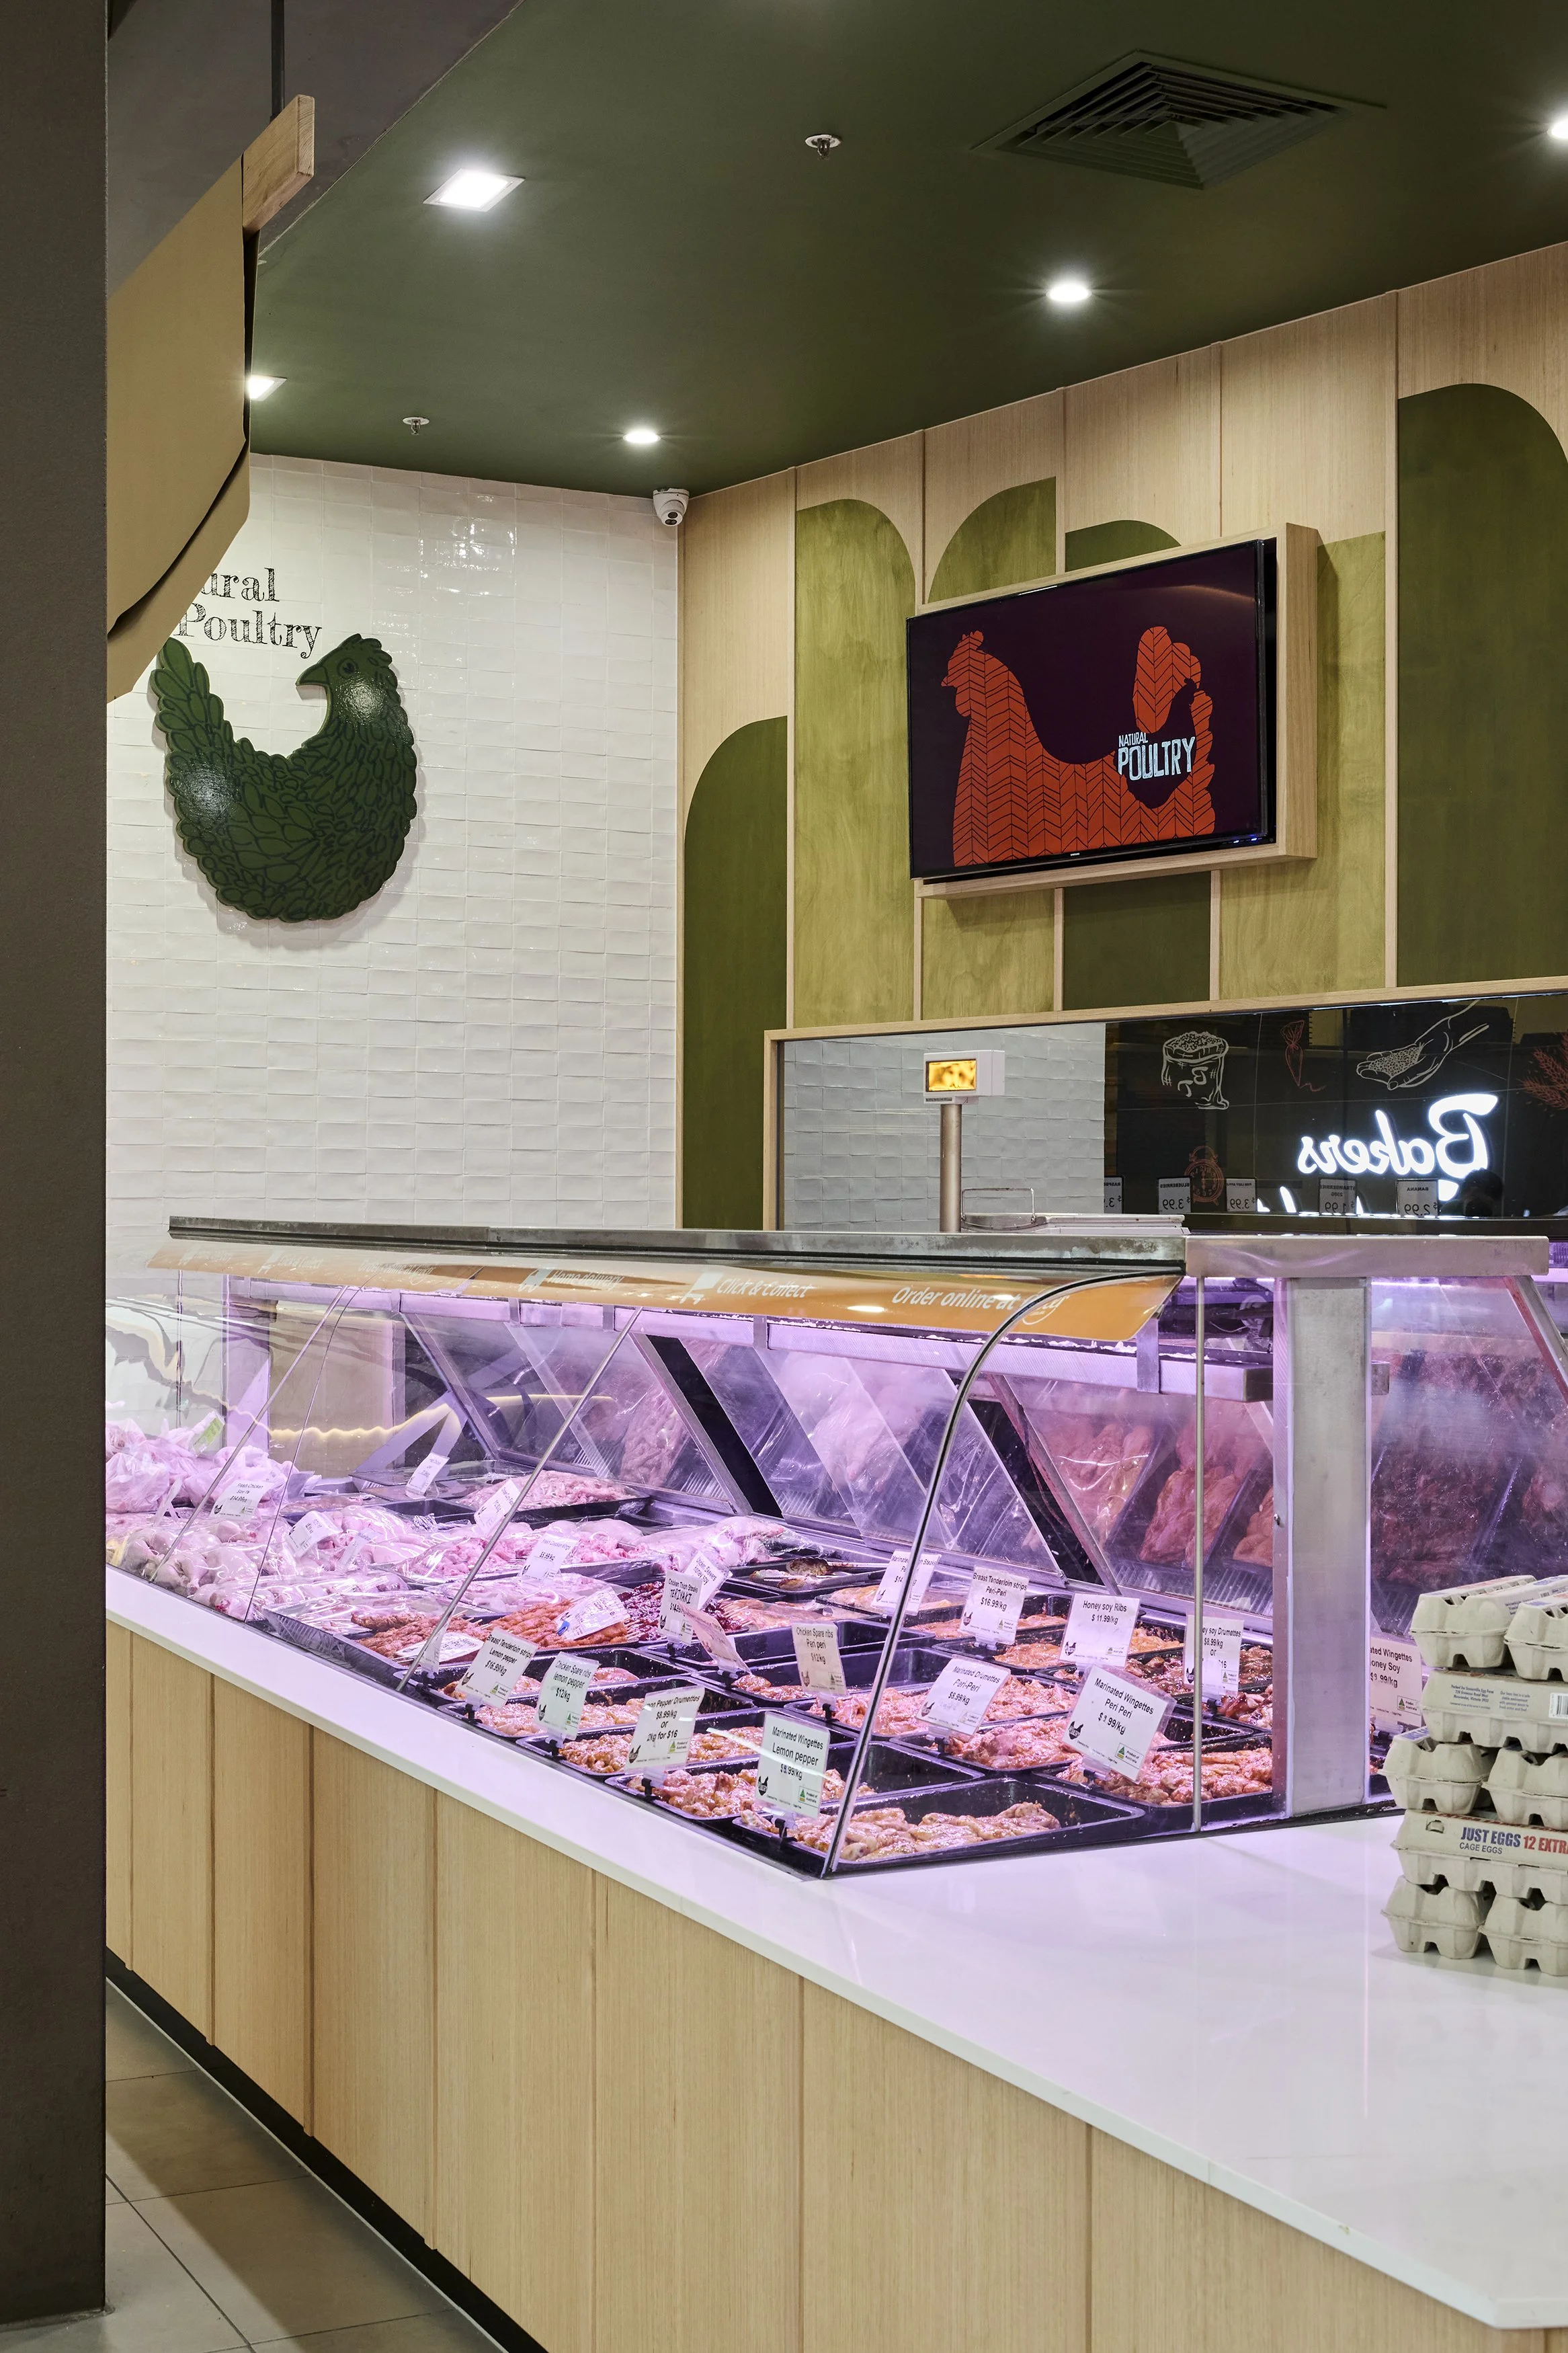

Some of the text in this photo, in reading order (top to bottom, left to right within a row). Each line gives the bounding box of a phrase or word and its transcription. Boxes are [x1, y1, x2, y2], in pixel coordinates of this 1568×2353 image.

[200, 567, 280, 602] ural
[173, 602, 323, 659] Poultry
[1118, 731, 1148, 748] NATURAL
[1118, 736, 1195, 781] POULTRY
[546, 1270, 624, 1291] Home delivery
[716, 1279, 812, 1298] Click & Collect
[892, 1287, 941, 1305] Order
[941, 1289, 995, 1309] online
[996, 1294, 1021, 1310] at
[669, 1579, 679, 1587] Chicken
[688, 1584, 698, 1593] Steaks
[973, 1572, 1027, 1591] Breast Tenderloin strips
[671, 1589, 692, 1604] TERIYAKI
[986, 1586, 1007, 1597] Peri-Peri
[981, 1597, 1007, 1611] $16.99/kg
[1083, 1601, 1127, 1612] Honey soy Ribs
[796, 1627, 833, 1638] Chicken Spare ribs
[1209, 1628, 1217, 1636] soy
[1218, 1628, 1241, 1637] Drumettes
[487, 1634, 500, 1644] Breast
[500, 1640, 520, 1652] Tenderloin
[520, 1649, 533, 1659] strips
[1204, 1638, 1223, 1649] $8.99/kg
[489, 1648, 517, 1664] Lemon pepper
[1383, 1648, 1412, 1662] Wingettes
[485, 1660, 507, 1676] $16.99/kg
[555, 1661, 591, 1678] Chicken Spare ribs
[1219, 1660, 1227, 1668] 16
[1372, 1660, 1401, 1674] oney Soy
[553, 1671, 585, 1689] lemon pepper
[952, 1666, 1000, 1683] Marinated Drumettes
[953, 1679, 981, 1692] Peri-Peri
[556, 1687, 571, 1702] $12/kg
[656, 1700, 673, 1708] Pepper
[673, 1696, 700, 1704] Drumettes
[1094, 1678, 1153, 1714] Marinated Wingettes
[656, 1710, 677, 1720] $8.99/kg
[1105, 1698, 1132, 1718] Peri Peri
[647, 1730, 677, 1742] 2kg for $16
[772, 1726, 823, 1750] Marinated Wingettes
[772, 1743, 818, 1766] Lemon pepper
[1460, 1827, 1489, 1843] JUST
[1490, 1831, 1521, 1847] EGGS
[1524, 1835, 1536, 1849] 12
[1460, 1842, 1502, 1855] CAGE EGGS
